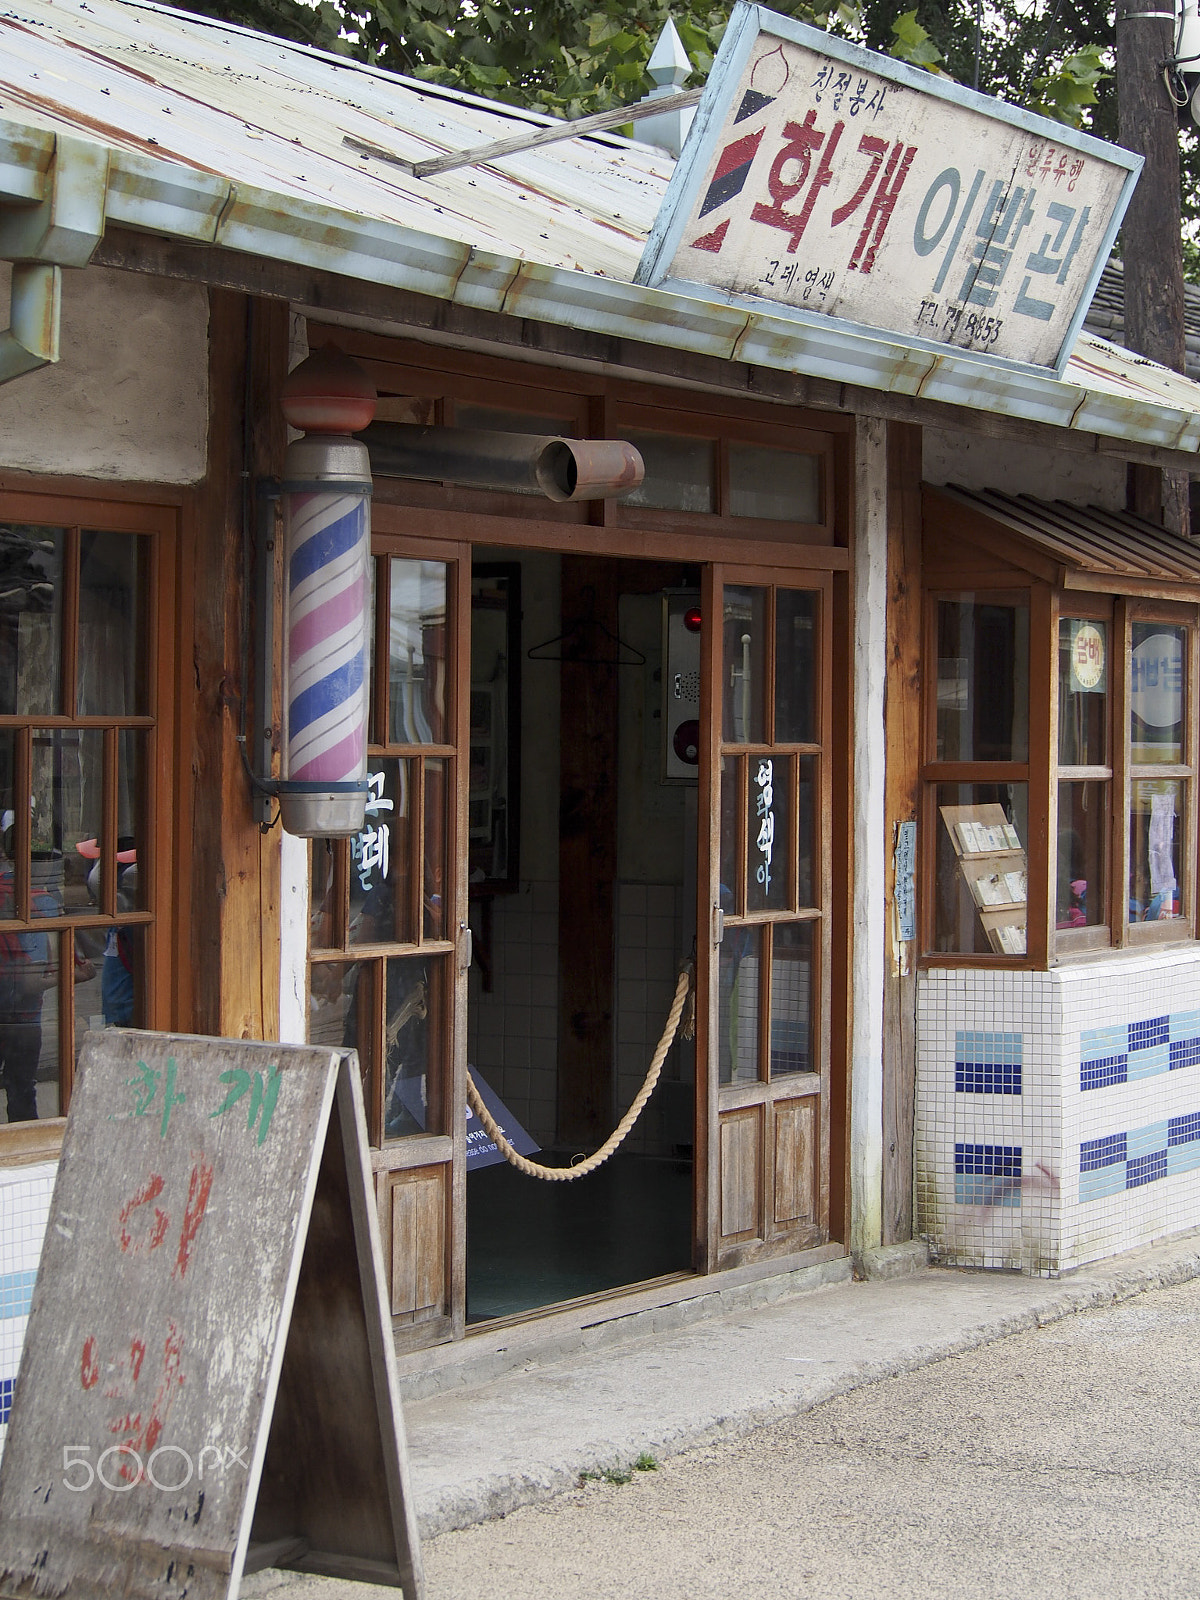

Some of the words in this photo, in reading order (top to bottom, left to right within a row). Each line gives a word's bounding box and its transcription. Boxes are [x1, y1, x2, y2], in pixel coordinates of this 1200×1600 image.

[810, 66, 887, 121] 친절봉사
[1026, 144, 1085, 193] 일류유행
[750, 109, 918, 275] 화개
[913, 167, 1092, 321] 이발관
[1077, 636, 1100, 666] 담배
